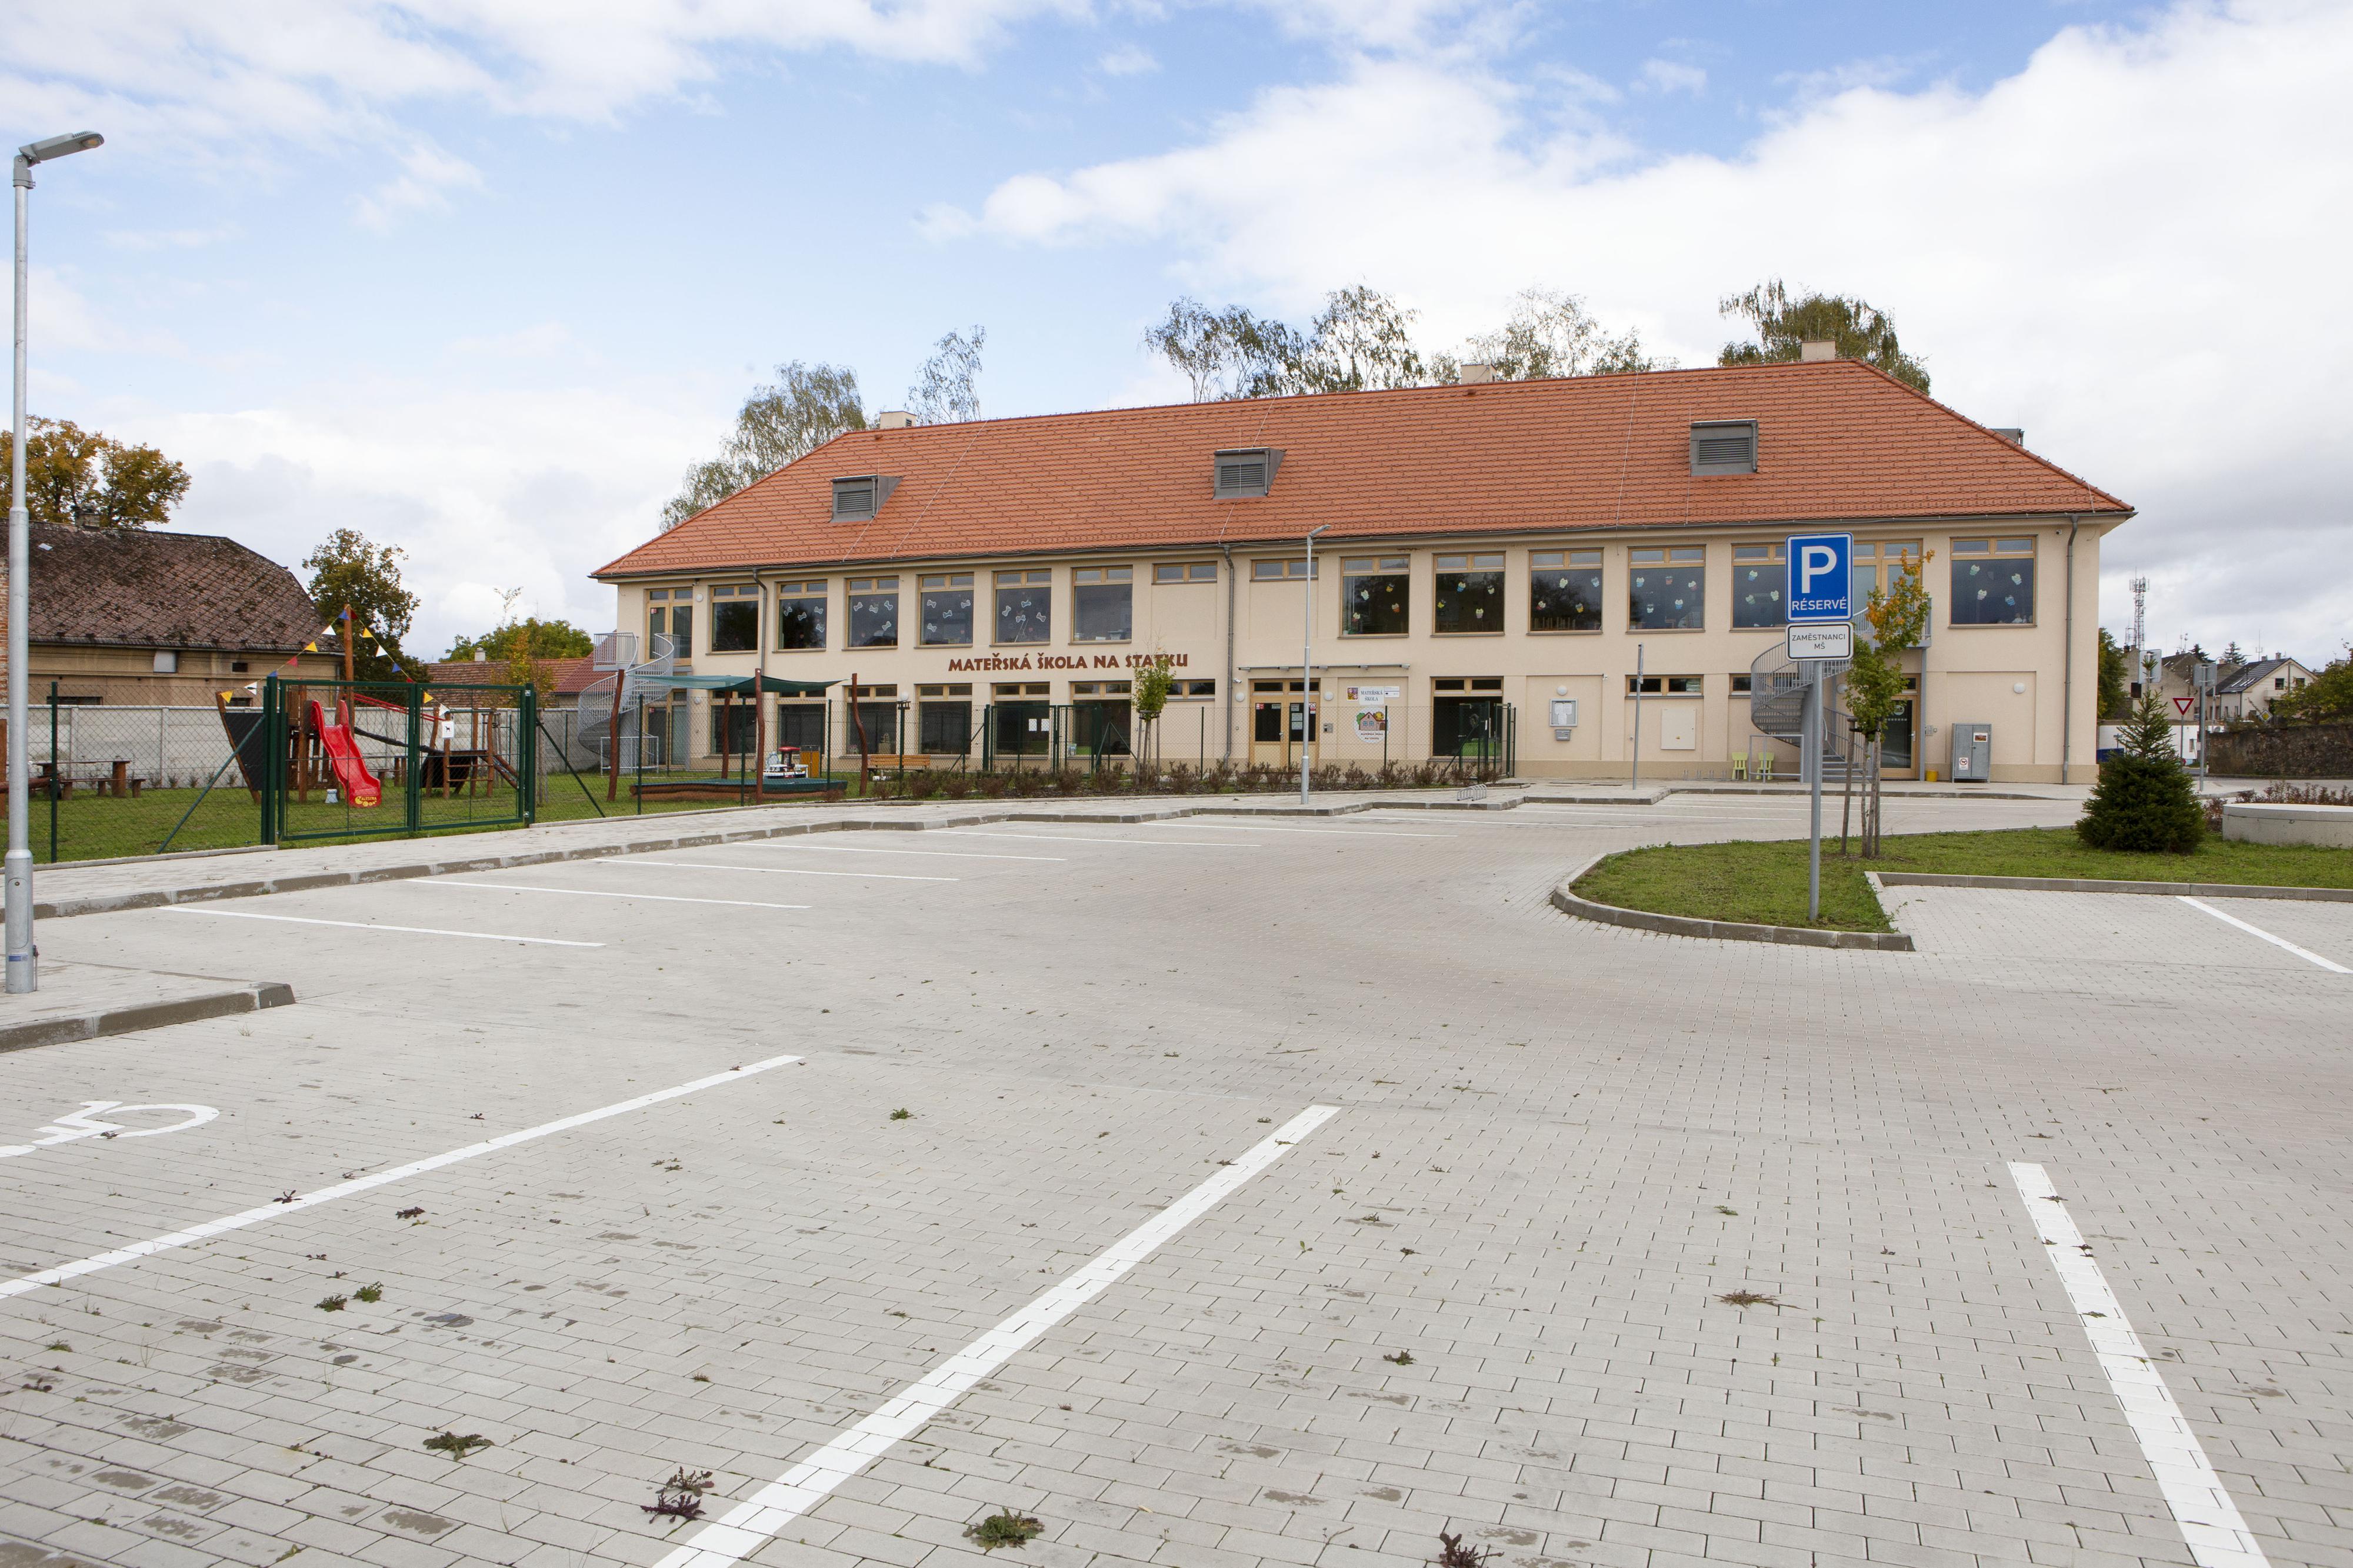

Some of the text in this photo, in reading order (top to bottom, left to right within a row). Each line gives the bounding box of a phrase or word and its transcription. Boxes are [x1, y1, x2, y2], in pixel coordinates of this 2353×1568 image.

[1801, 546, 1837, 593] P
[1792, 596, 1847, 610] RÉSERVÉ
[1792, 633, 1845, 641] ZAMĚSTNANCI
[948, 652, 1032, 671] MATEŘSKÁ
[1037, 652, 1088, 669] ŠKOLA
[1094, 655, 1119, 668] NA
